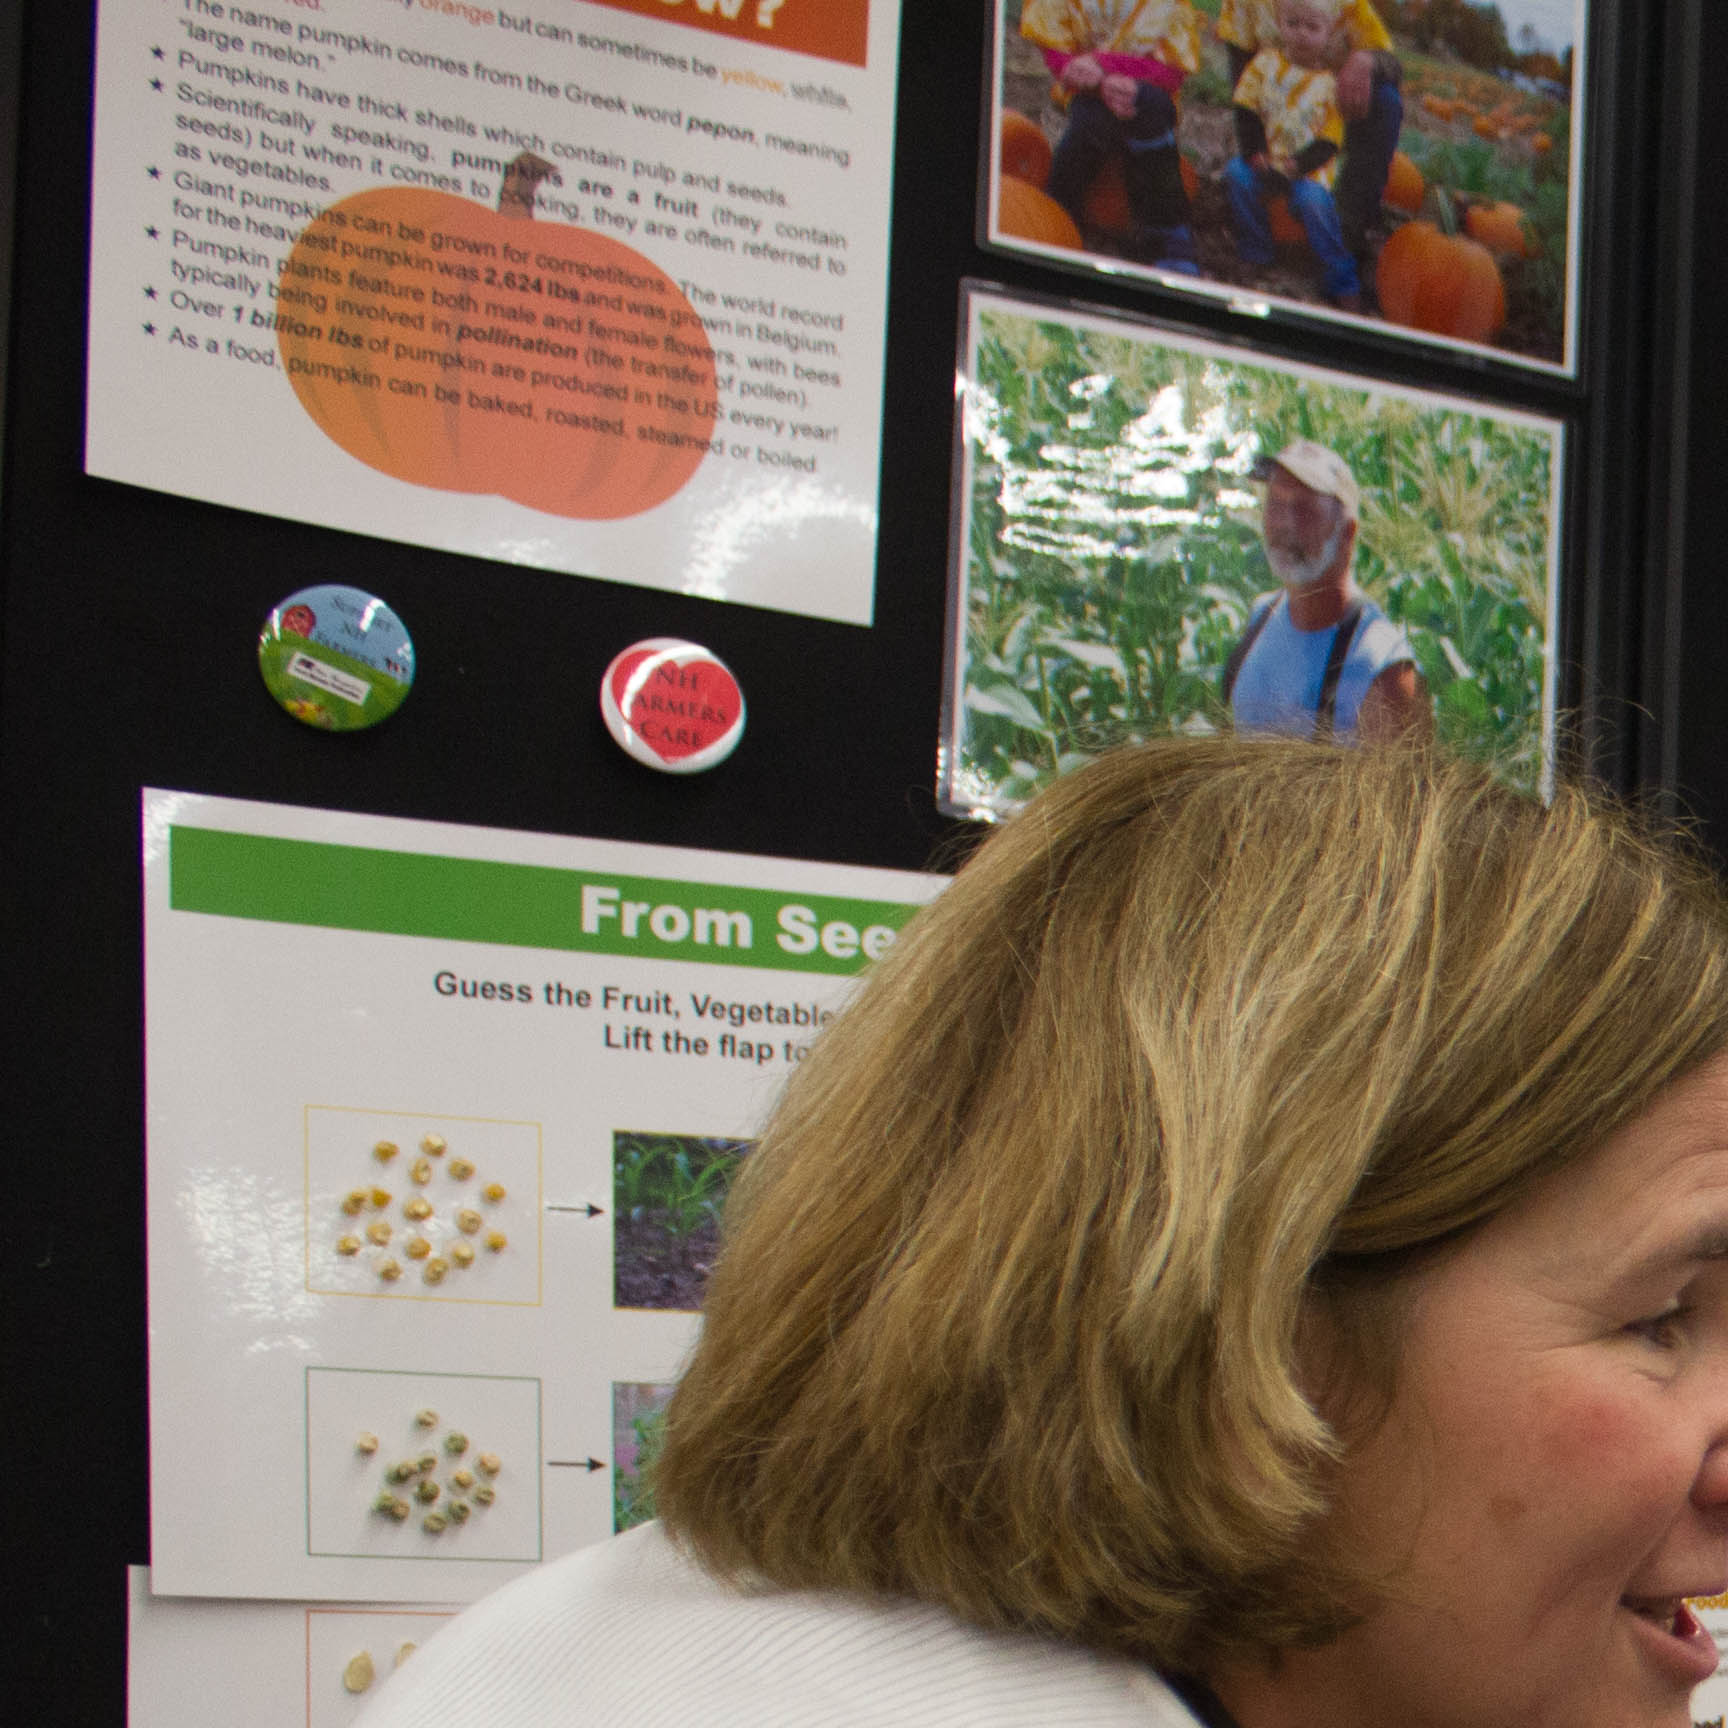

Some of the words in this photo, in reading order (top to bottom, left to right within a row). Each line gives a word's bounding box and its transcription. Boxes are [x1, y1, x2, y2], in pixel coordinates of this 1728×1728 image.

[497, 7, 534, 36] but
[533, 20, 574, 45] can
[576, 31, 690, 74] sometimes
[690, 55, 719, 80] be
[229, 6, 293, 36] name
[297, 23, 392, 60] pumpkin
[396, 47, 469, 78] comes
[473, 60, 523, 90] from
[526, 74, 561, 99] the
[564, 82, 627, 115] Greek
[632, 101, 682, 127] word
[765, 133, 851, 167] meaning
[176, 47, 291, 96] Pumpkins
[295, 77, 352, 110] have
[356, 93, 409, 124] thick
[413, 107, 479, 139] shells
[481, 124, 546, 157] which
[550, 140, 628, 173] contain
[631, 158, 678, 187] pulp
[680, 170, 722, 194] and
[173, 140, 203, 163] as
[167, 324, 200, 351] As
[204, 337, 221, 356] a
[288, 355, 383, 391] pumpkin
[387, 377, 428, 399] can
[433, 378, 463, 407] be
[729, 443, 751, 461] or
[755, 445, 818, 475] boiled
[656, 666, 698, 690] NH
[634, 693, 728, 724] ARMERS
[581, 885, 753, 948] From
[434, 971, 533, 1004] Guess
[544, 981, 592, 1008] the
[602, 986, 680, 1019] Fruit,
[604, 1024, 652, 1052] Lift
[662, 1029, 708, 1056] the
[719, 1033, 774, 1065] flap
